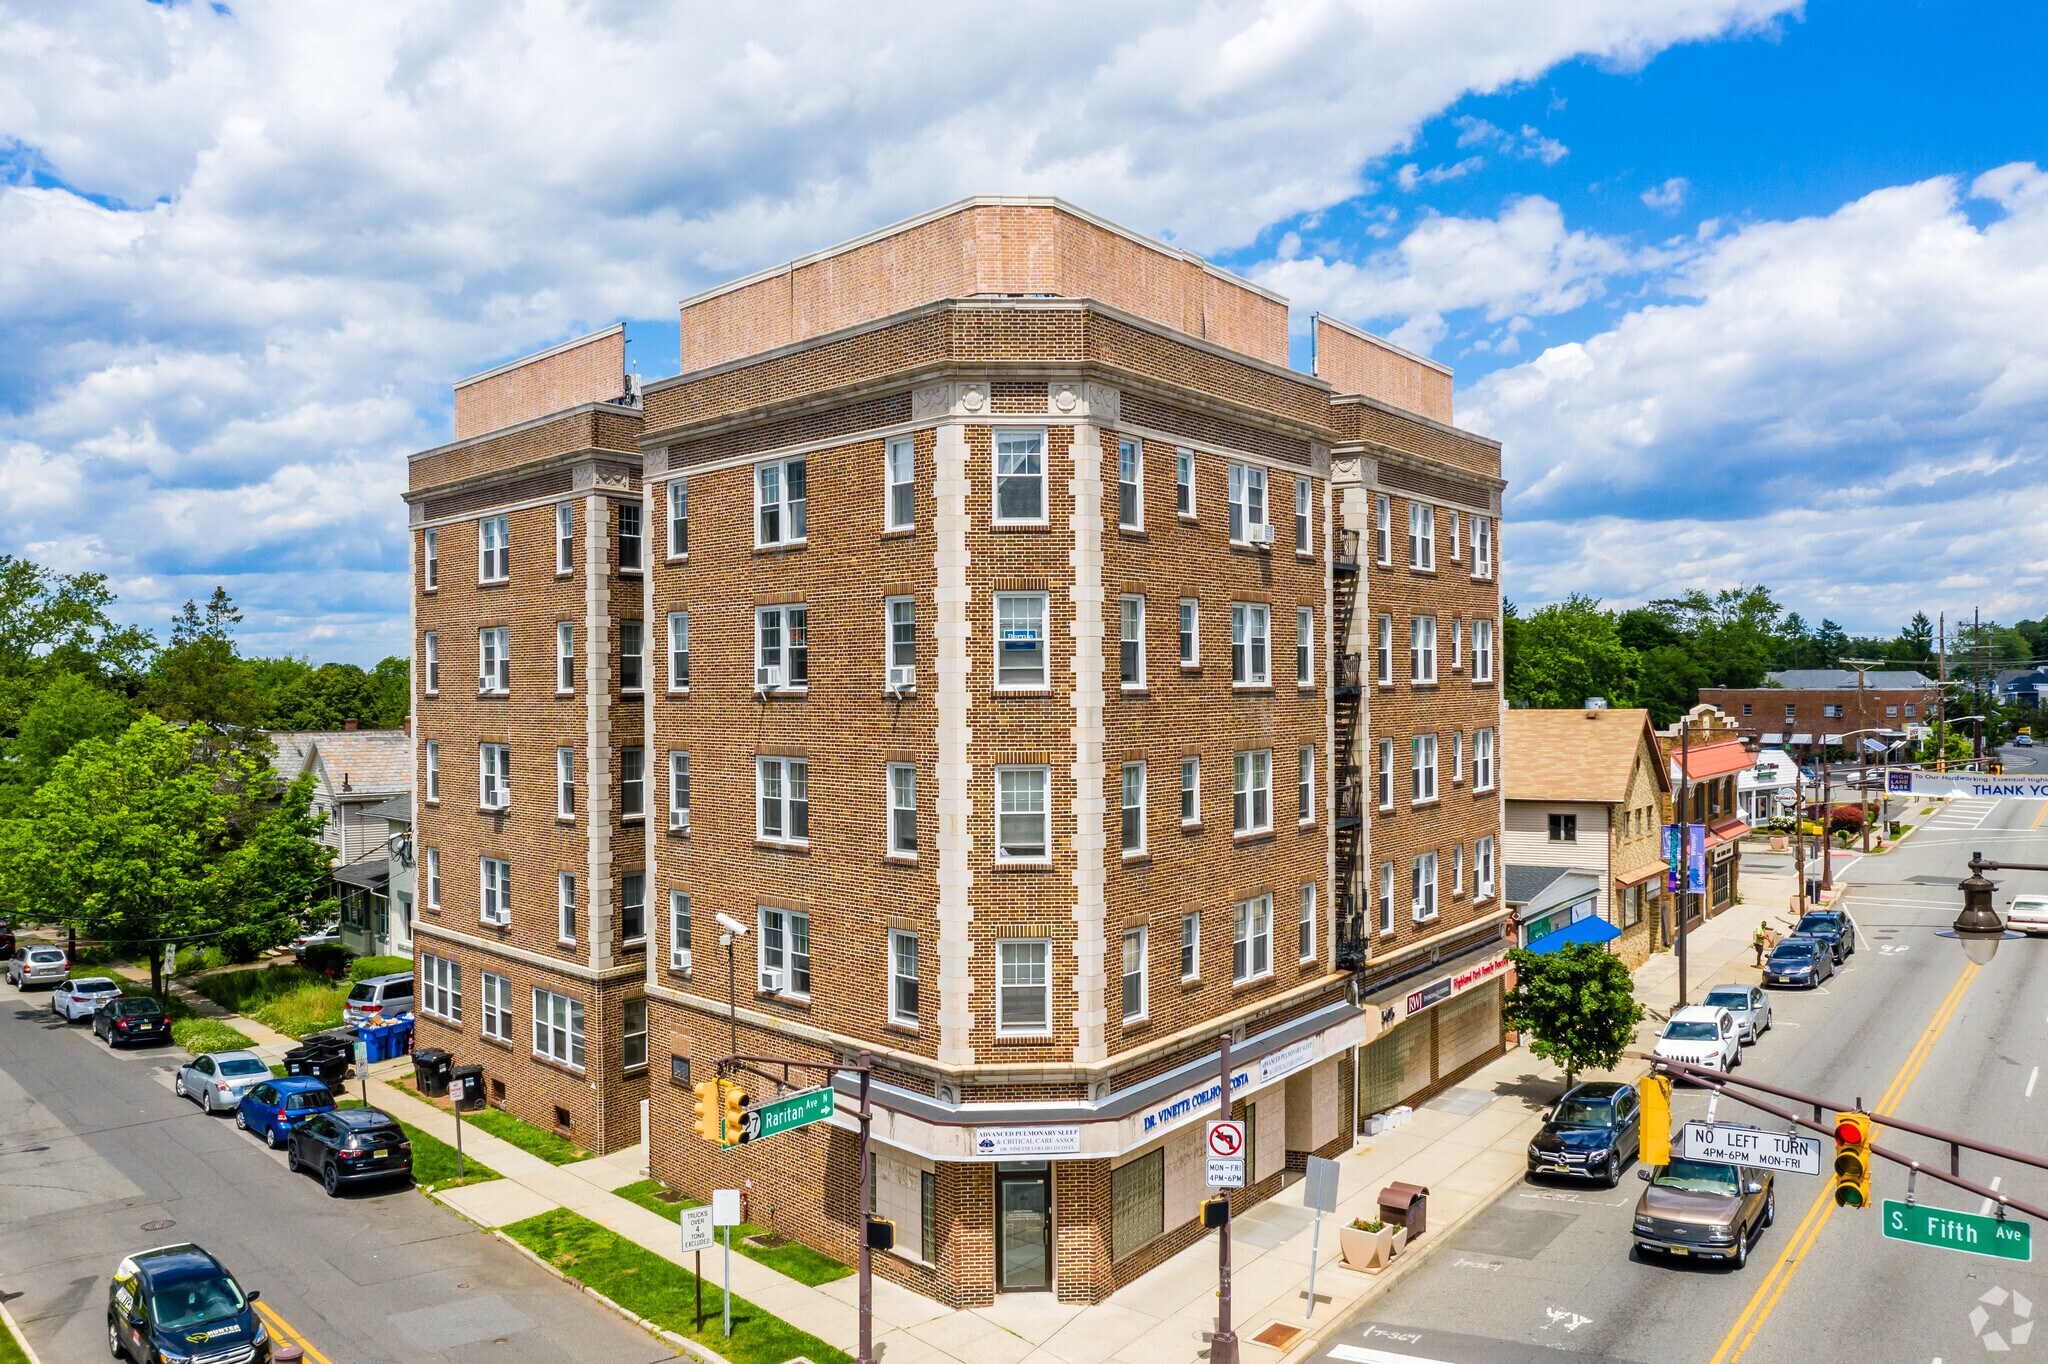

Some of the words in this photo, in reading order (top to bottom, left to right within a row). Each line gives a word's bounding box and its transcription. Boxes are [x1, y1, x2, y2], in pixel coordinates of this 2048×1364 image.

[1972, 784, 2024, 796] THANK
[823, 1093, 828, 1104] N
[1144, 1115, 1157, 1131] DR.
[1158, 1098, 1191, 1122] VINETTE
[1192, 1085, 1221, 1107] COELHO
[766, 1107, 804, 1129] Raritan
[806, 1099, 818, 1109] Ave
[1695, 1129, 1714, 1144] NO
[1727, 1132, 1758, 1149] LEFT
[1774, 1138, 1808, 1156] TURN
[1703, 1147, 1749, 1162] 4PM-6PM
[1759, 1154, 1800, 1169] MON-FRI
[1209, 1174, 1241, 1182] 4PM-6PM
[687, 1211, 708, 1219] TRUCKS
[690, 1218, 704, 1226] OVER
[1891, 1211, 1908, 1232] S.
[1928, 1216, 1977, 1244] Fifth
[1996, 1226, 2021, 1241] Ave
[691, 1232, 705, 1240] TONS
[685, 1238, 710, 1248] EXCLUDED
[207, 1324, 240, 1335] HUNTER
